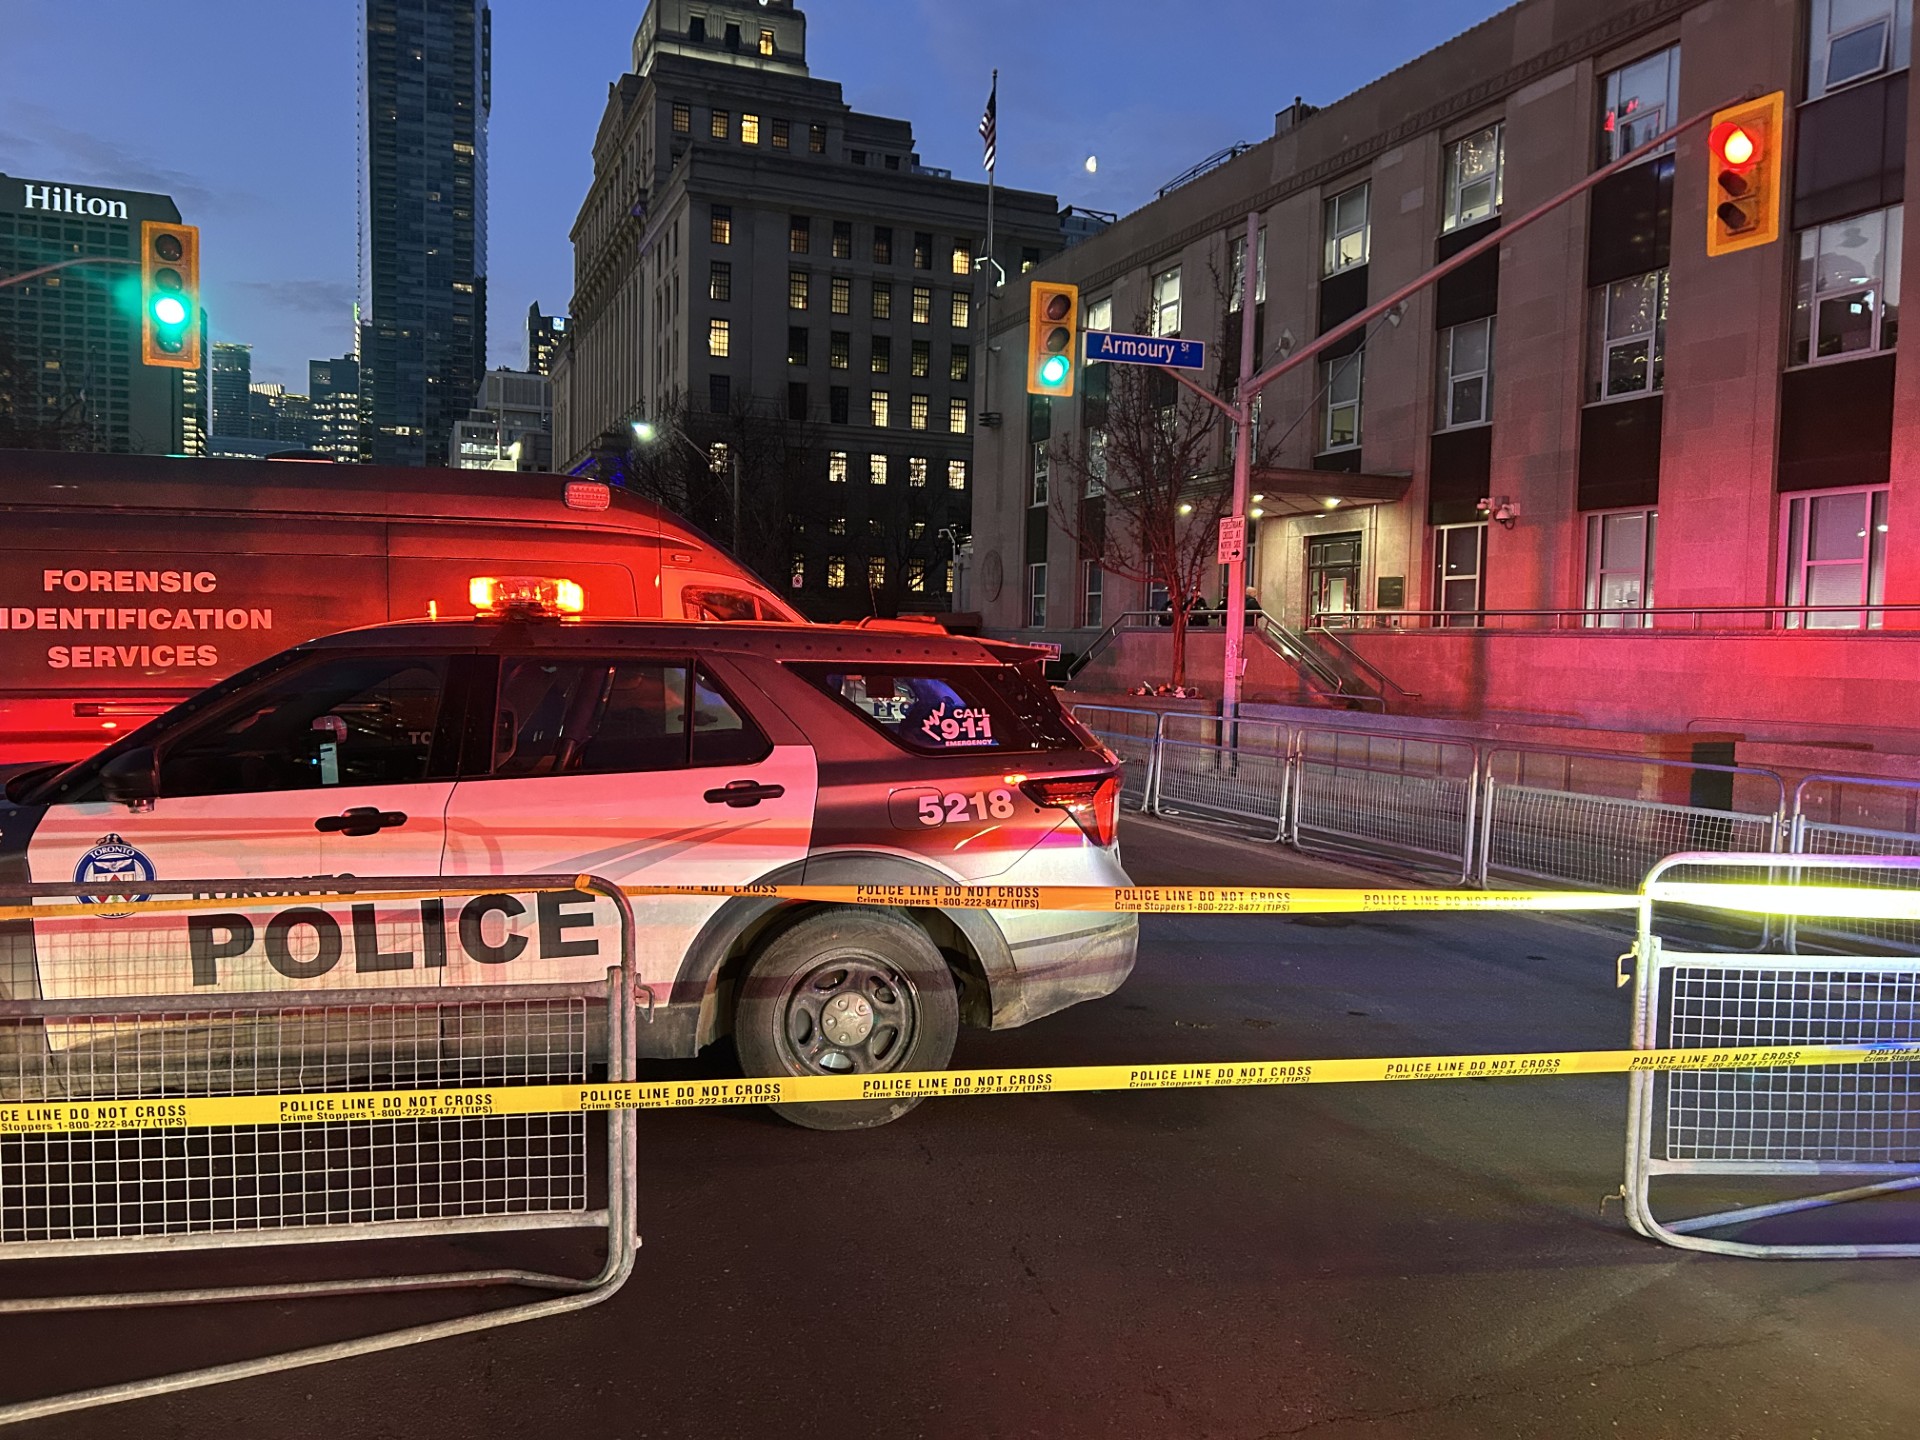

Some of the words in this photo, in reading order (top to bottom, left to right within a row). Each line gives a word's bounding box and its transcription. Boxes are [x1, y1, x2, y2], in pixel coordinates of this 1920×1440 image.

[24, 184, 128, 220] Hilton
[1100, 334, 1175, 364] Armoury
[1180, 342, 1190, 352] St
[44, 569, 217, 592] FORENSIC
[0, 608, 272, 630] IDENTIFICATION
[47, 644, 218, 668] SERVICES
[953, 708, 990, 719] CALL
[940, 717, 992, 740] 9-1-1
[918, 788, 1015, 826] 5218
[88, 846, 135, 859] TORONTO
[857, 885, 904, 896] POLICE
[910, 886, 938, 896] LINE
[945, 886, 962, 896] DO
[967, 886, 992, 897] NOT
[998, 886, 1039, 898] CROSS
[1114, 889, 1160, 900] POLICE
[1166, 890, 1193, 901] LINE
[1200, 890, 1215, 902] DO
[1221, 891, 1244, 901] NOT
[1250, 891, 1291, 903] CROSS
[856, 896, 885, 904] Crime
[888, 896, 930, 906] Stoppers
[934, 898, 1008, 907] 1-800-222-8477
[1011, 899, 1039, 909] (TIPS)
[1114, 901, 1142, 910] Crime
[1144, 902, 1186, 912] Stoppers
[1188, 902, 1261, 912] 1-800-222-8477
[1263, 903, 1290, 912] (TIPS)
[1364, 894, 1408, 906] POLICE
[1413, 895, 1440, 906] LINE
[187, 892, 600, 988] POLICE
[1386, 1062, 1432, 1073] POLICE
[1437, 1062, 1465, 1072] LINE
[1470, 1061, 1486, 1070] DO
[1492, 1060, 1516, 1069] NOT
[1521, 1058, 1561, 1068] CROSS
[1632, 1056, 1676, 1065] POLICE
[1680, 1054, 1708, 1064] LINE
[1712, 1054, 1729, 1062] DO
[1732, 1053, 1758, 1062] NOT
[1762, 1052, 1801, 1060] CROSS
[1130, 1070, 1178, 1081] POLICE
[1183, 1068, 1212, 1080] LINE
[1218, 1068, 1234, 1078] DO
[1240, 1067, 1264, 1078] NOT
[1270, 1066, 1312, 1077] CROSS
[1458, 1069, 1528, 1077] 1-800-222-8477
[1530, 1067, 1558, 1076] (TIPS)
[864, 1080, 912, 1090] POLICE
[918, 1078, 948, 1089] LINE
[954, 1077, 971, 1087] DO
[978, 1076, 1004, 1086] NOT
[1010, 1074, 1052, 1085] CROSS
[1205, 1077, 1280, 1086] 1-800-222-8477
[580, 1090, 632, 1102] POLICE
[638, 1088, 670, 1100] LINE
[677, 1086, 694, 1098] DO
[702, 1086, 728, 1096] NOT
[736, 1084, 780, 1095] CROSS
[895, 1090, 939, 1098] Stoppers
[942, 1086, 1020, 1094] 1-800-222-8477
[1022, 1084, 1051, 1092] (TIPS)
[280, 1100, 334, 1112] POLICE
[342, 1098, 375, 1110] LINE
[382, 1097, 401, 1108] DO
[408, 1096, 437, 1108] NOT
[444, 1094, 492, 1106] CROSS
[614, 1100, 661, 1109] Stoppers
[664, 1096, 746, 1106] 1-800-222-8477
[750, 1094, 780, 1104] (TIPS)
[26, 1108, 62, 1120] LINE
[70, 1108, 89, 1120] DO
[98, 1106, 128, 1118] NOT
[135, 1104, 186, 1118] CROSS
[280, 1112, 313, 1122] Crime
[316, 1110, 366, 1120] Stoppers
[370, 1106, 456, 1118] 1-800-222-8477
[460, 1105, 493, 1115] (TIPS)
[1, 1122, 53, 1132] Stoppers
[56, 1119, 148, 1131] 1-800-222-8477
[152, 1118, 188, 1128] (TIPS)
